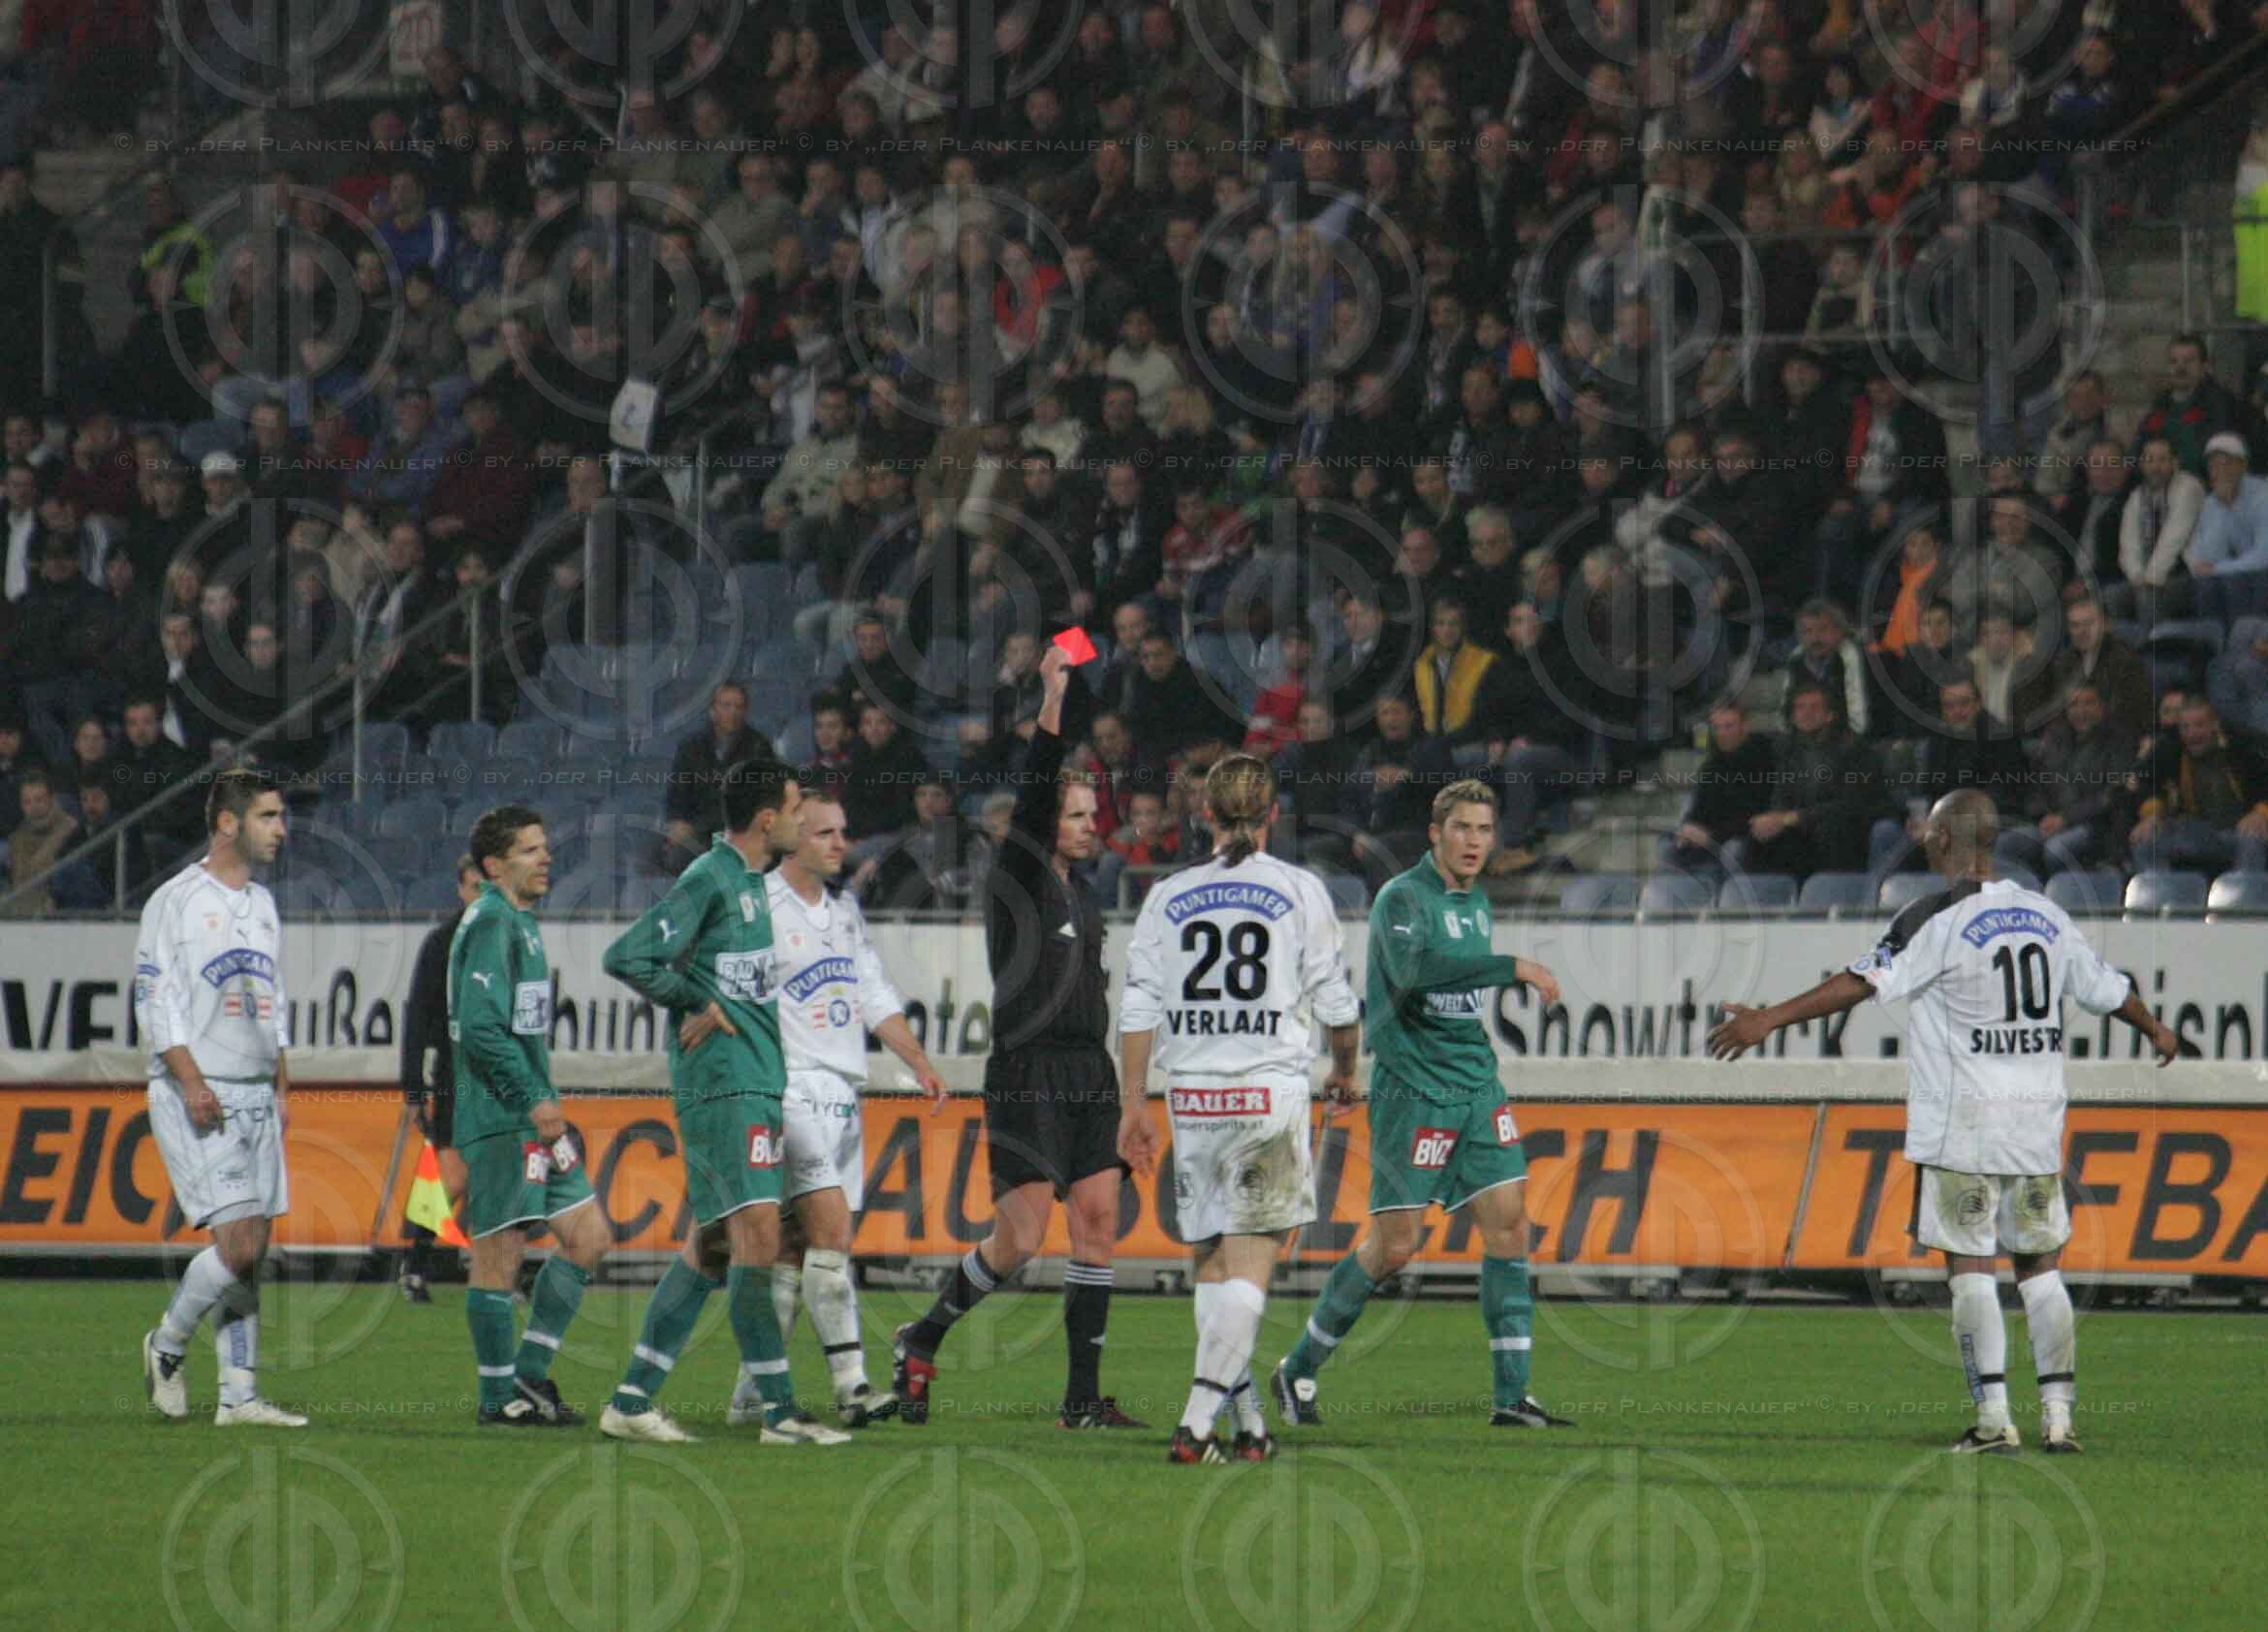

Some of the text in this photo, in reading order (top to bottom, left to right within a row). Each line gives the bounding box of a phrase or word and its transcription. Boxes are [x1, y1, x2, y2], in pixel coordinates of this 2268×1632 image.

[1169, 887, 1288, 919] PUNTIGAMER
[1181, 921, 1270, 1001] 28
[1992, 942, 2051, 1021] 10
[1167, 1010, 1282, 1036] VERLAAT
[1174, 1091, 1265, 1113] BAUER
